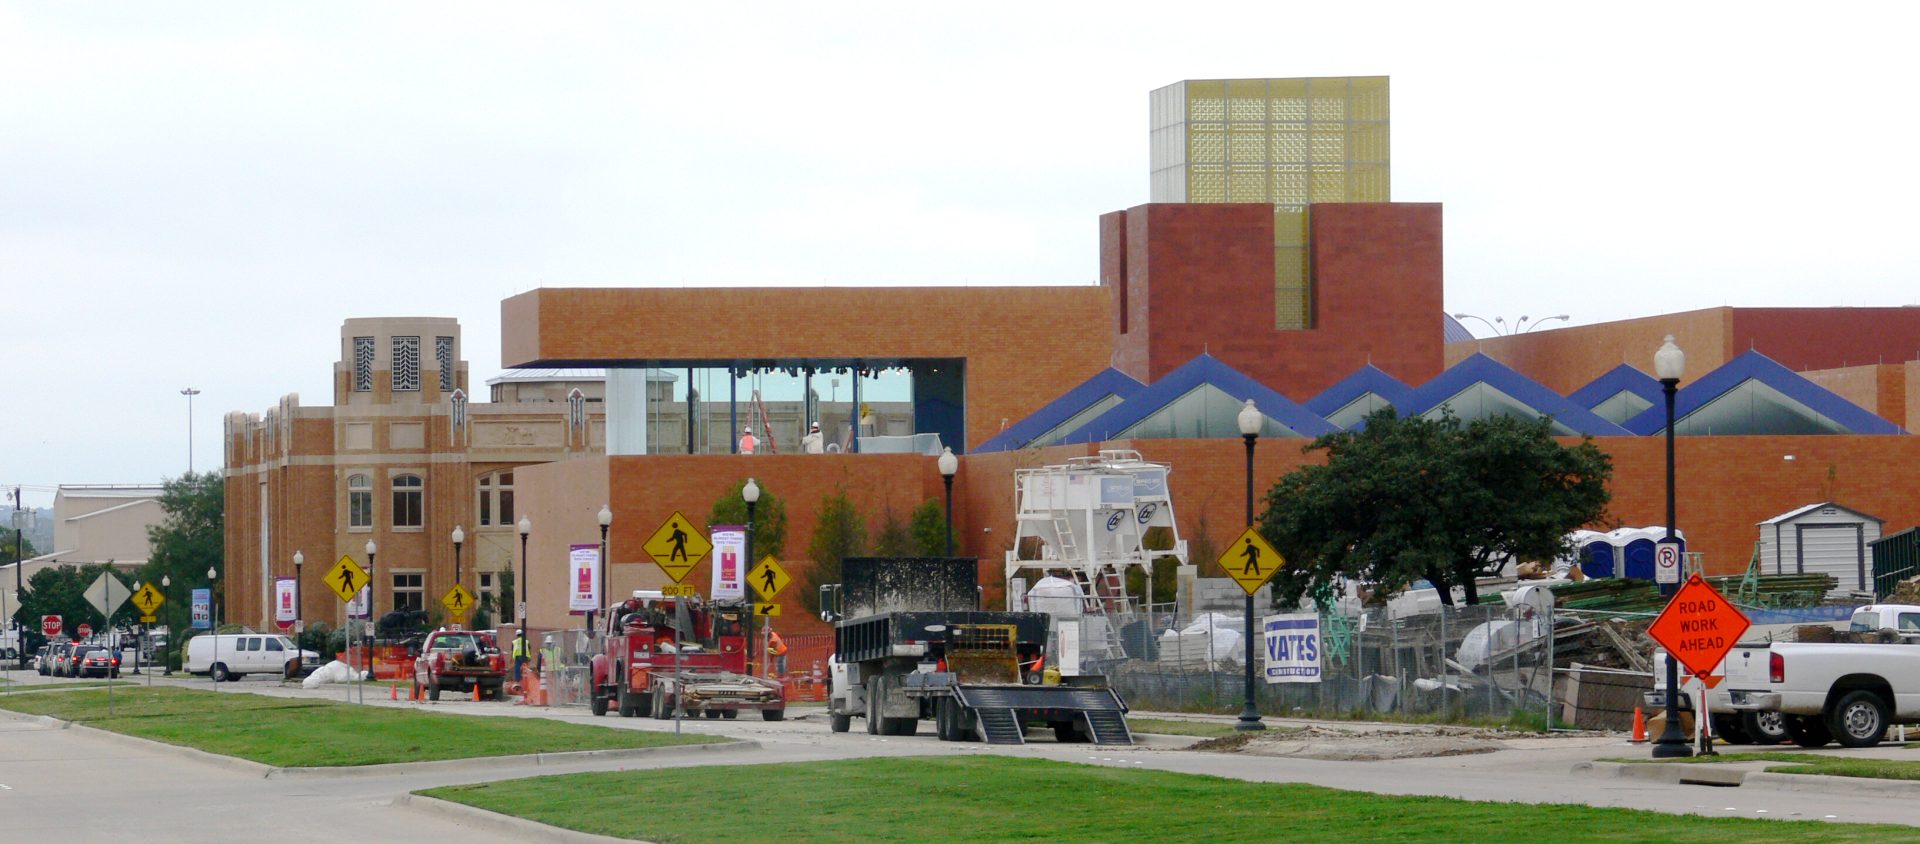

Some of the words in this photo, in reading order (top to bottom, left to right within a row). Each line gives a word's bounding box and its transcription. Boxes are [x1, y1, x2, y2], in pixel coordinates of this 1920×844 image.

[662, 586, 679, 596] 200
[683, 586, 693, 595] FT
[1679, 600, 1716, 614] ROAD
[43, 621, 61, 630] STOP
[1680, 618, 1718, 633] WORK
[1266, 633, 1318, 661] YATES
[1679, 636, 1725, 651] AHEAD
